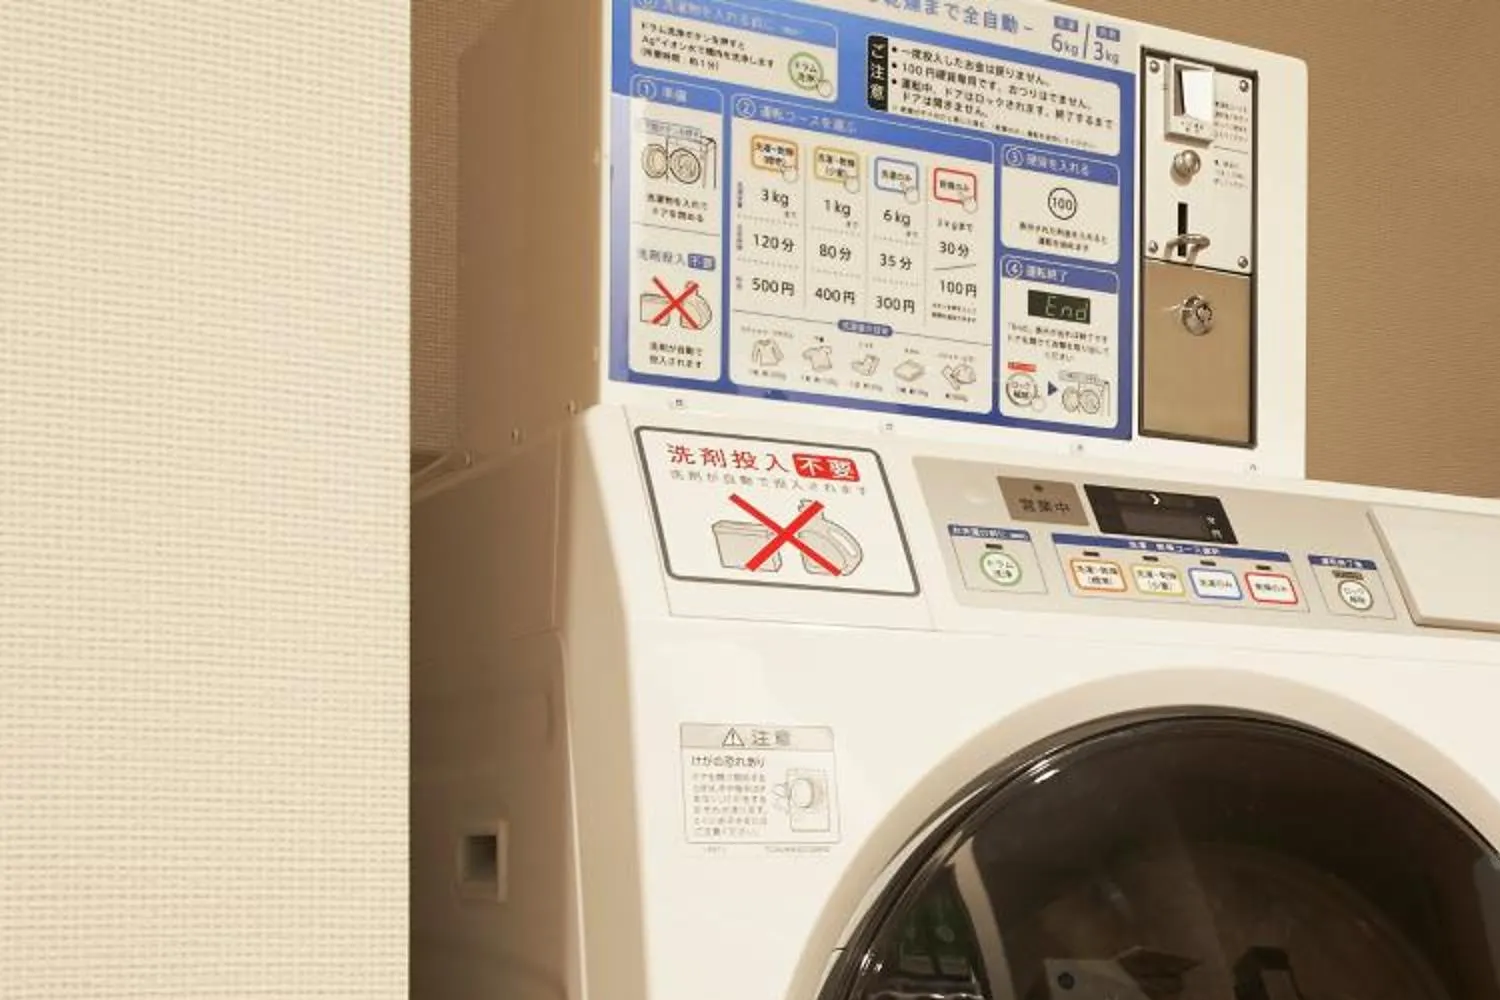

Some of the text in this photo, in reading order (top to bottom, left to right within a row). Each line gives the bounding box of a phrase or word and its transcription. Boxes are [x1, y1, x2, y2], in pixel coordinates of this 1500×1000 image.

[1052, 197, 1073, 211] 100
[754, 233, 795, 253] 120分
[819, 243, 852, 261] 80分
[939, 241, 970, 258] 30分
[879, 253, 913, 271] 35分
[752, 278, 795, 297] 500円
[815, 287, 855, 305] 400円
[939, 279, 977, 298] 100円
[875, 295, 915, 315] 300円
[666, 443, 856, 479] 洗剤投入 不要
